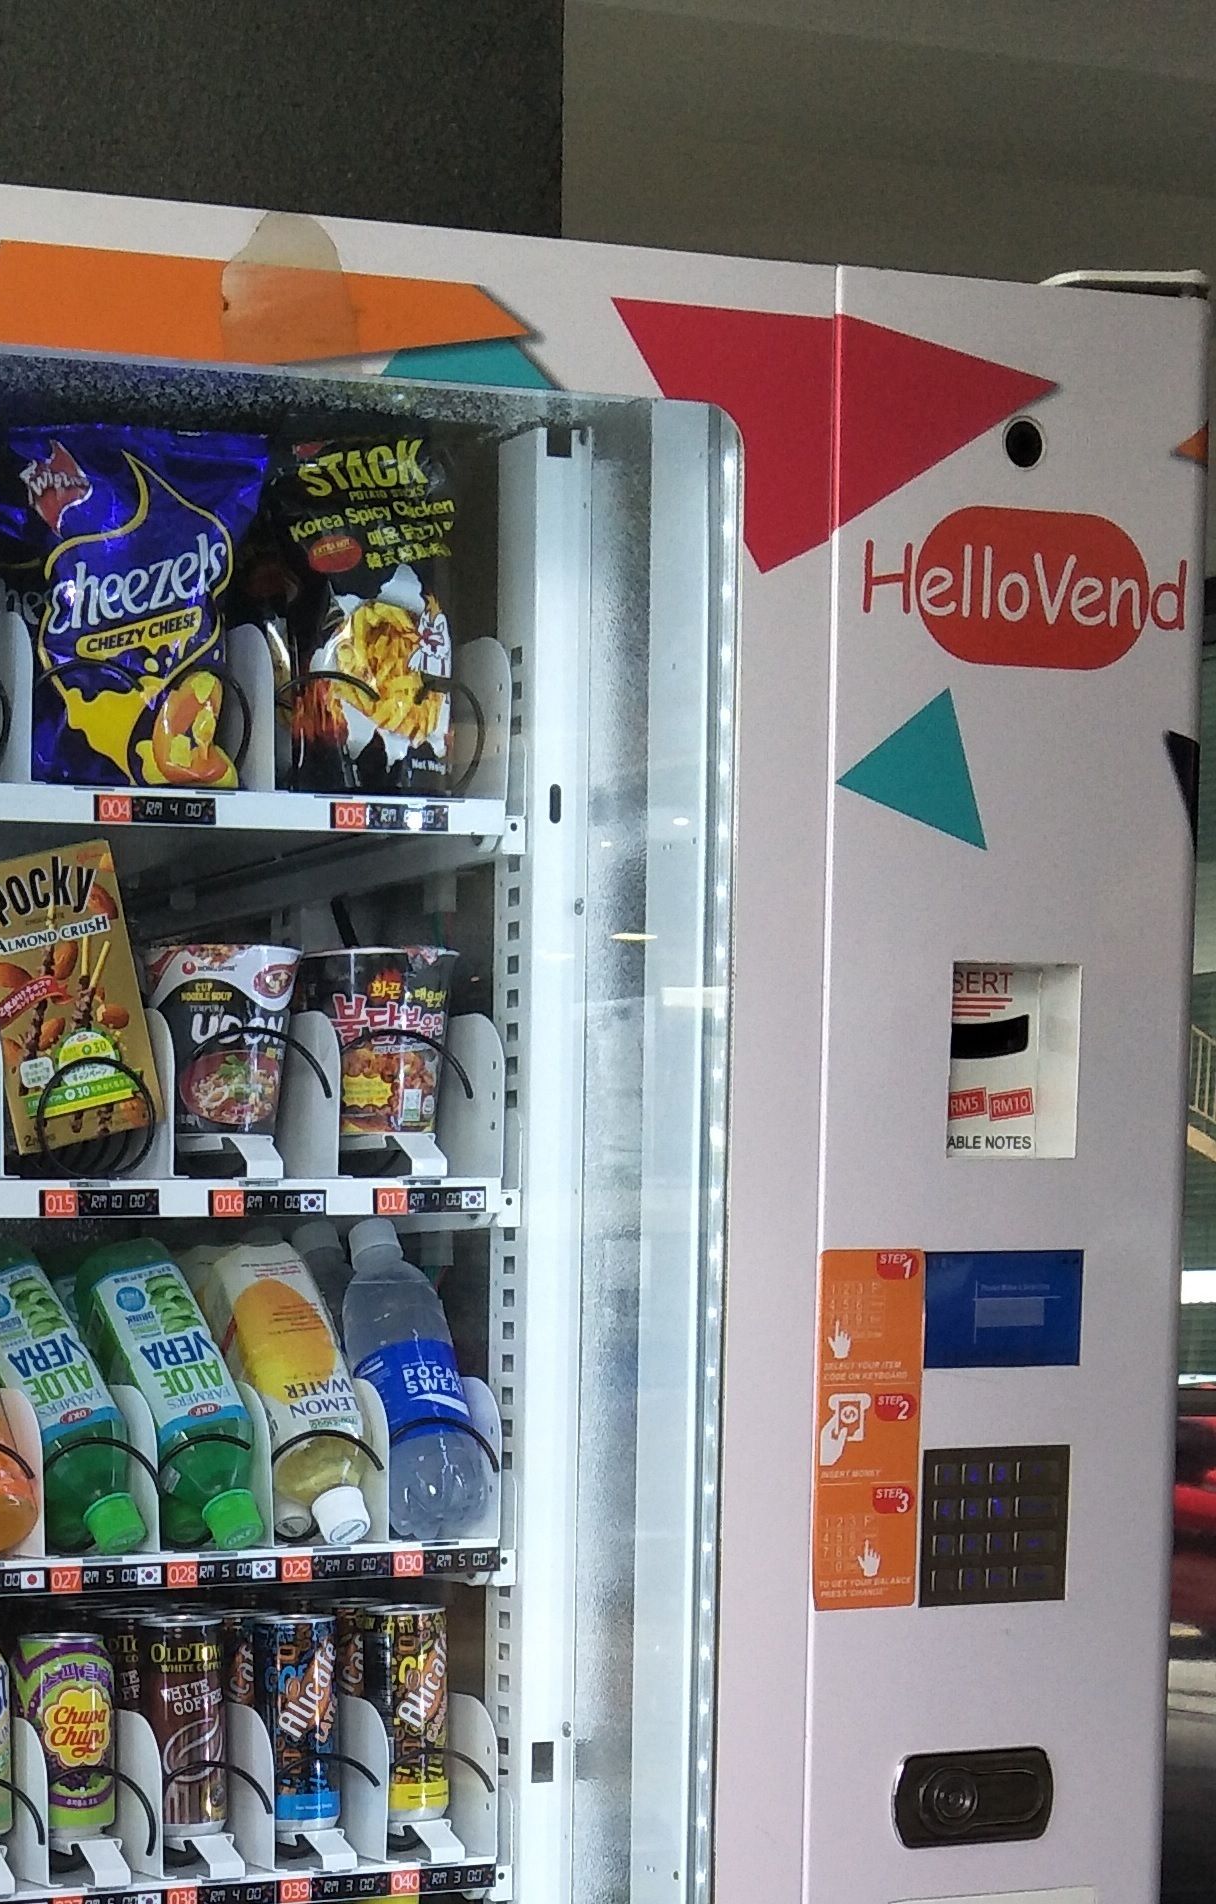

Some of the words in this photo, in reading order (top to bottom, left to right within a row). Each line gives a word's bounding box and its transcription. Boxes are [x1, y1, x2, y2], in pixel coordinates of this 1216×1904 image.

[298, 439, 428, 496] STACK
[289, 514, 344, 543] Korea
[345, 506, 392, 526] Spicy
[863, 539, 1187, 631] HelloVend
[86, 629, 144, 653] CHEEZY
[147, 612, 198, 643] CHEESE
[100, 799, 130, 820] 004
[336, 807, 364, 827] 005
[61, 915, 109, 941] CRUSH
[181, 992, 210, 1001] NOODLE
[211, 991, 233, 1001] SOUP
[195, 982, 214, 991] CUP
[190, 1014, 284, 1046] UDON
[950, 1098, 979, 1113] RM5
[992, 1095, 1029, 1112] RM10
[985, 1135, 1032, 1149] NOTES
[46, 1193, 74, 1214] 015
[214, 1194, 244, 1212] 016
[378, 1192, 407, 1211] 017
[879, 1253, 907, 1265] STEP
[902, 1258, 913, 1279] 1
[7, 1334, 87, 1377] VERA
[139, 1331, 217, 1370] VERA
[857, 1361, 880, 1370] YOUR
[23, 1361, 94, 1406] ALOE
[153, 1360, 224, 1398] ALOE
[284, 1378, 352, 1399] WATER
[289, 1396, 359, 1418] LEMON
[878, 1395, 903, 1406] STEP
[897, 1400, 910, 1421] 2
[875, 1488, 902, 1499] STEP
[896, 1492, 909, 1513] 3
[168, 1565, 197, 1584] 028
[283, 1560, 311, 1578] 029
[395, 1554, 423, 1573] 030
[52, 1570, 80, 1590] 027
[160, 1679, 210, 1702] WHITE
[173, 1688, 223, 1716] COFFEE
[53, 1706, 106, 1730] Chupa
[50, 1726, 105, 1757] Chups
[282, 1882, 312, 1901] 039
[392, 1874, 419, 1892] 040
